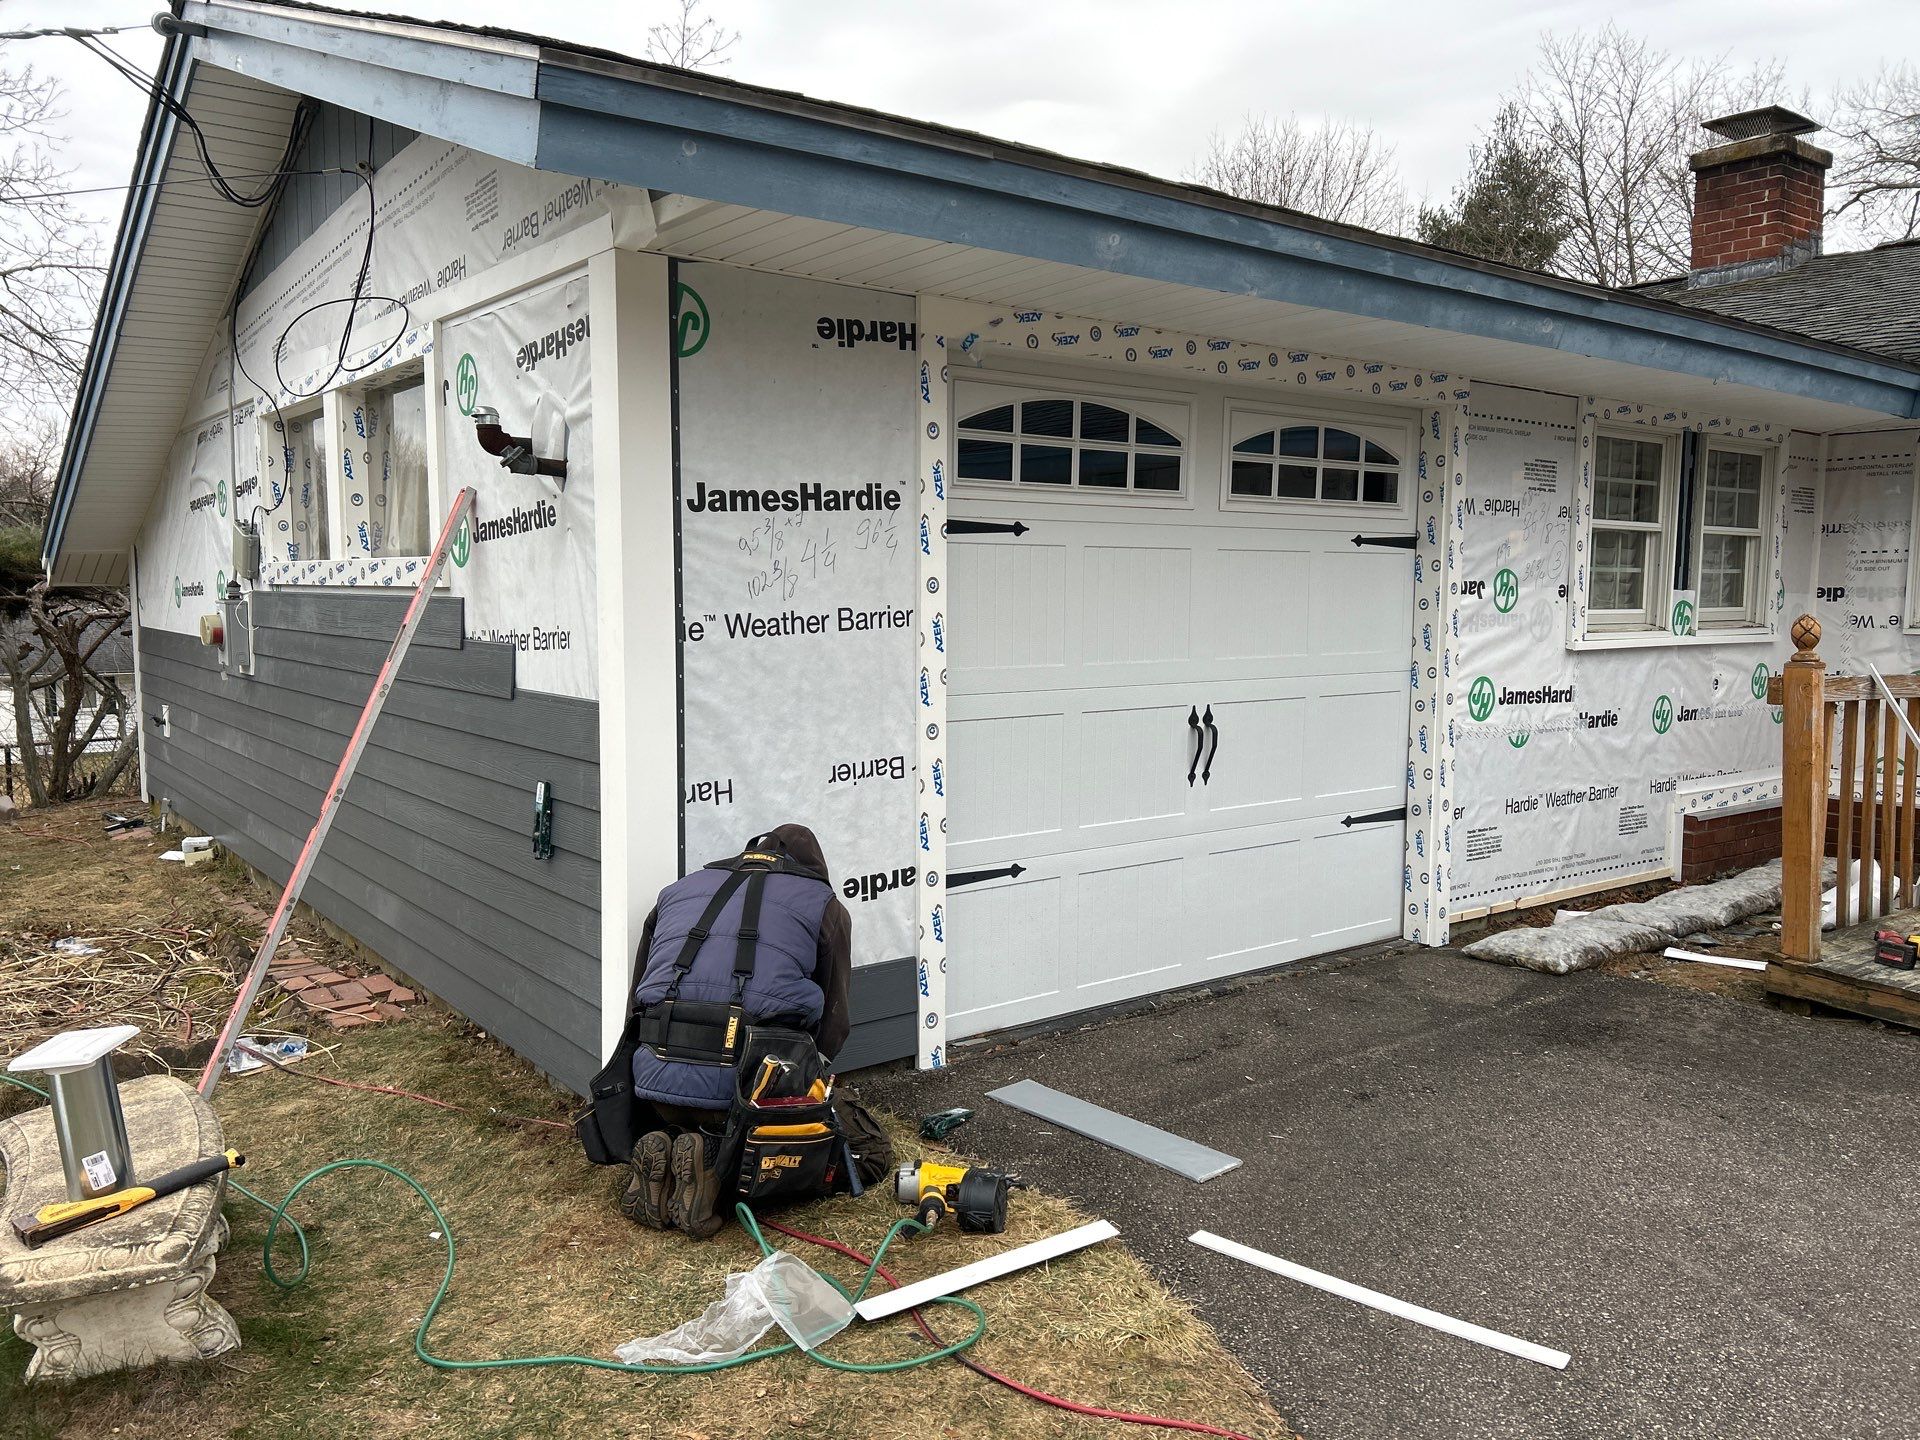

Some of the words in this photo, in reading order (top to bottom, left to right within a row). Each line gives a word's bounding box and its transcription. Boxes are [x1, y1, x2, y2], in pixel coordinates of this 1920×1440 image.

[543, 178, 593, 228] Weather
[502, 211, 540, 251] Barrier
[1018, 312, 1043, 323] AZEK
[1056, 334, 1080, 346] AZEK
[1117, 325, 1140, 338] AZEK
[1153, 347, 1173, 359] AZEK
[1241, 360, 1260, 371] AZEK
[920, 367, 931, 403] AZEK
[354, 411, 365, 438] AZEK
[1431, 413, 1441, 440] AZEK
[344, 453, 353, 480] AZEK
[931, 465, 944, 501] AZEK
[473, 500, 557, 544] JamesHardie
[854, 518, 882, 550] 96
[1428, 518, 1436, 545] AZEK
[359, 525, 370, 552] AZEK
[920, 519, 931, 556] AZEK
[1415, 557, 1423, 584] AZEK
[747, 570, 773, 599] 102
[724, 610, 829, 639] Weather
[837, 605, 914, 632] Barrier
[931, 617, 944, 652] AZEK
[533, 625, 571, 651] Barrier
[1424, 625, 1432, 652] AZEK
[920, 672, 930, 707] AZEK
[1412, 664, 1420, 689] AZEK
[1499, 685, 1573, 705] JamesHard
[828, 755, 905, 785] Barrier
[930, 763, 944, 797] AZEK
[1546, 789, 1587, 809] Weather
[1588, 784, 1619, 801] Barrier
[920, 817, 930, 852] AZEK
[1415, 832, 1423, 858] AZEK
[1494, 873, 1511, 881] OVERLAP
[1511, 870, 1528, 878] VERTICAL
[930, 909, 944, 943] AZEK
[919, 964, 930, 998] AZEK
[724, 1017, 739, 1049] DEWALT
[761, 1155, 803, 1170] DEWALT
